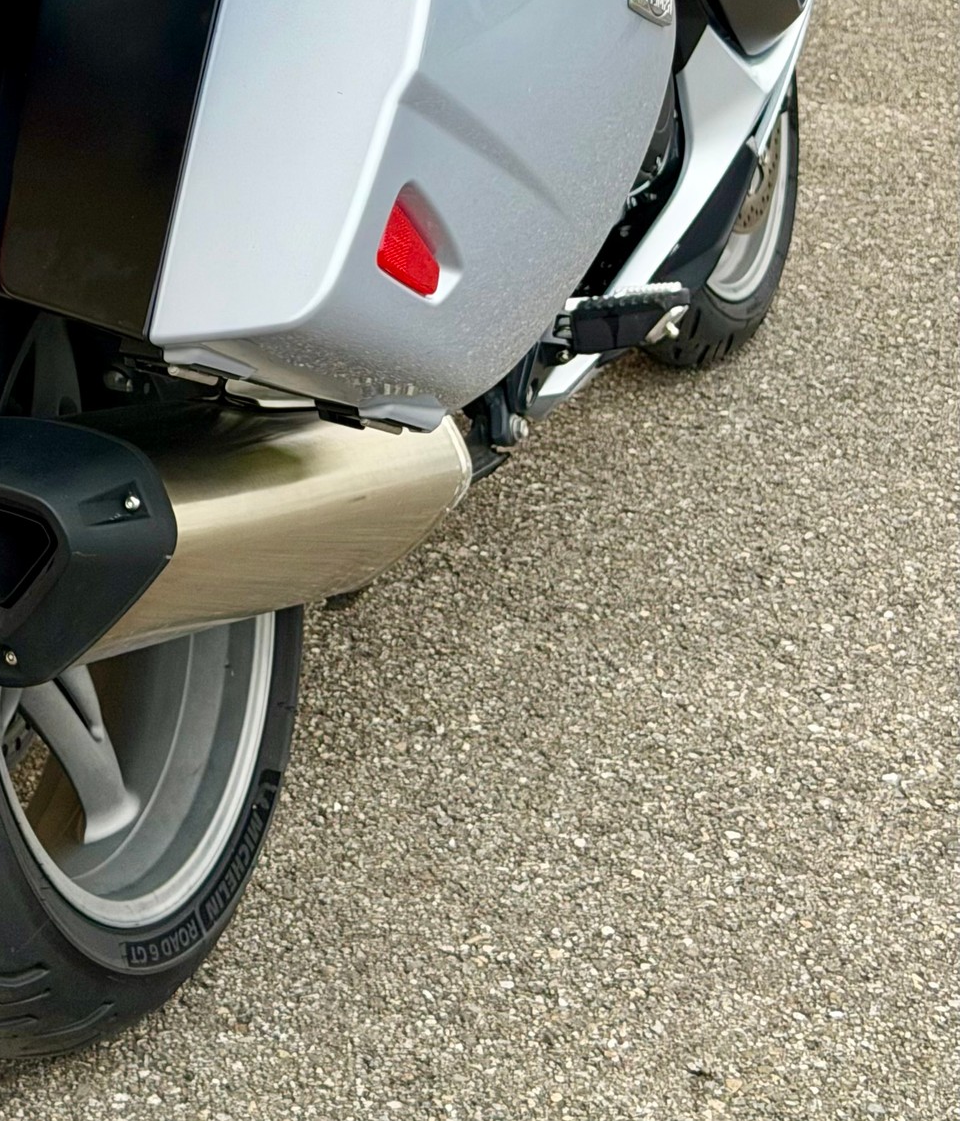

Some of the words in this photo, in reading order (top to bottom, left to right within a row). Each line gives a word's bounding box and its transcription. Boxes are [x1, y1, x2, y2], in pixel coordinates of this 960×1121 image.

[205, 810, 264, 923] MICHELIN
[161, 919, 199, 956] ROAD
[130, 945, 147, 964] GT
[149, 944, 158, 961] 6
